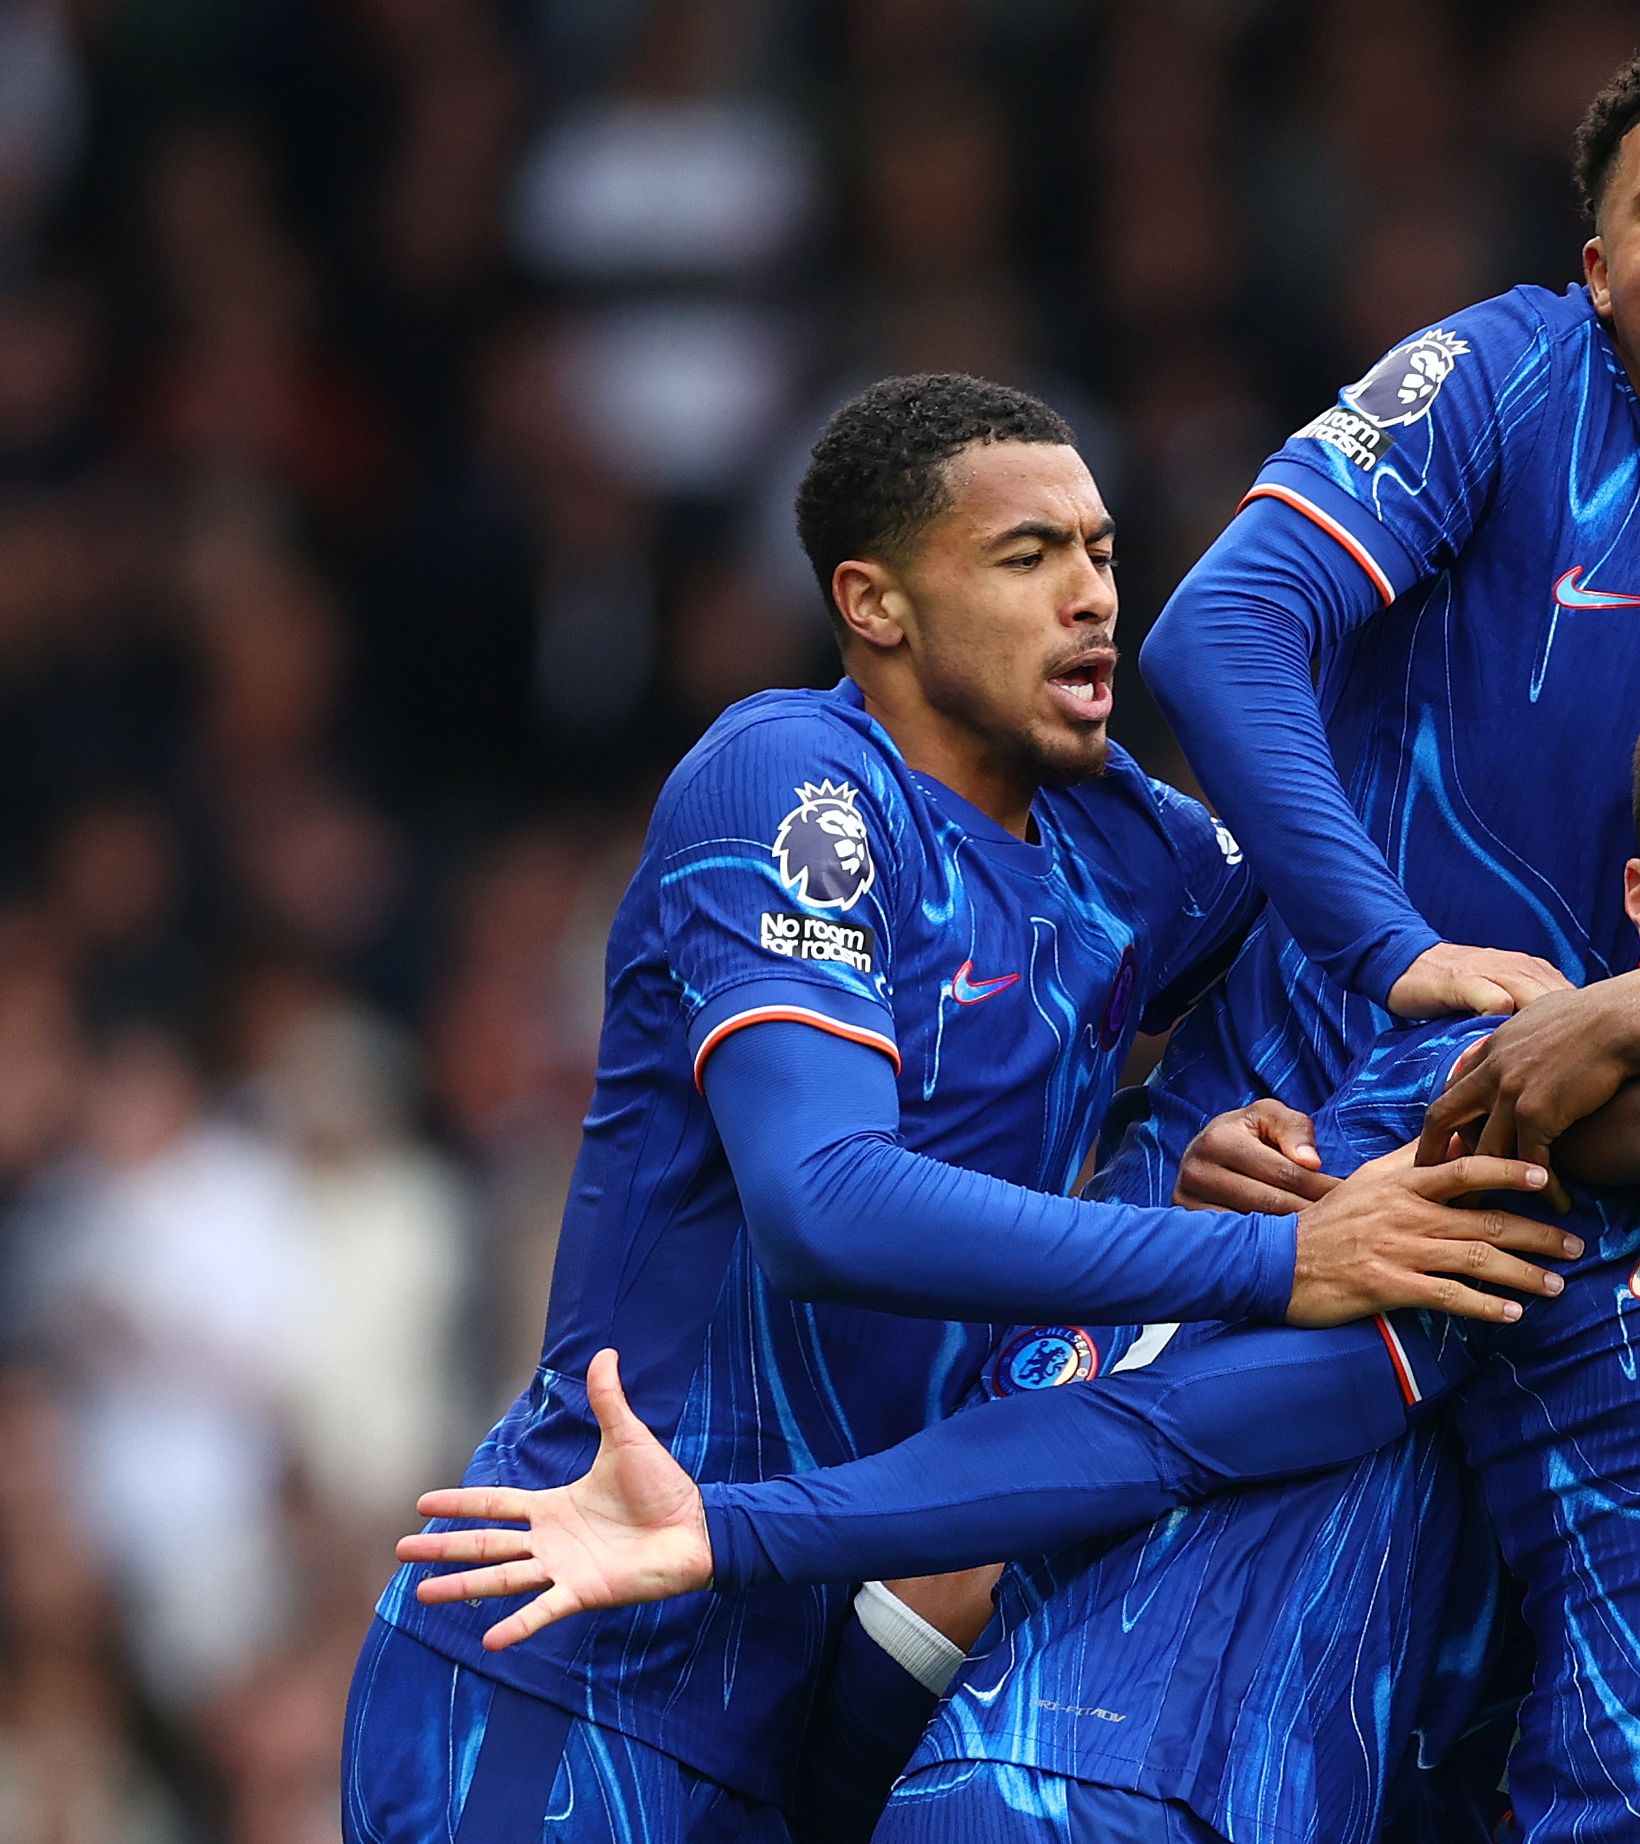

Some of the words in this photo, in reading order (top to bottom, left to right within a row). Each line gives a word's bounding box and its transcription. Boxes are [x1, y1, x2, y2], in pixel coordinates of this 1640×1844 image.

[1322, 411, 1380, 449] room
[761, 912, 800, 938] No
[804, 919, 864, 950] room
[1035, 1328, 1090, 1358] CHELSEA
